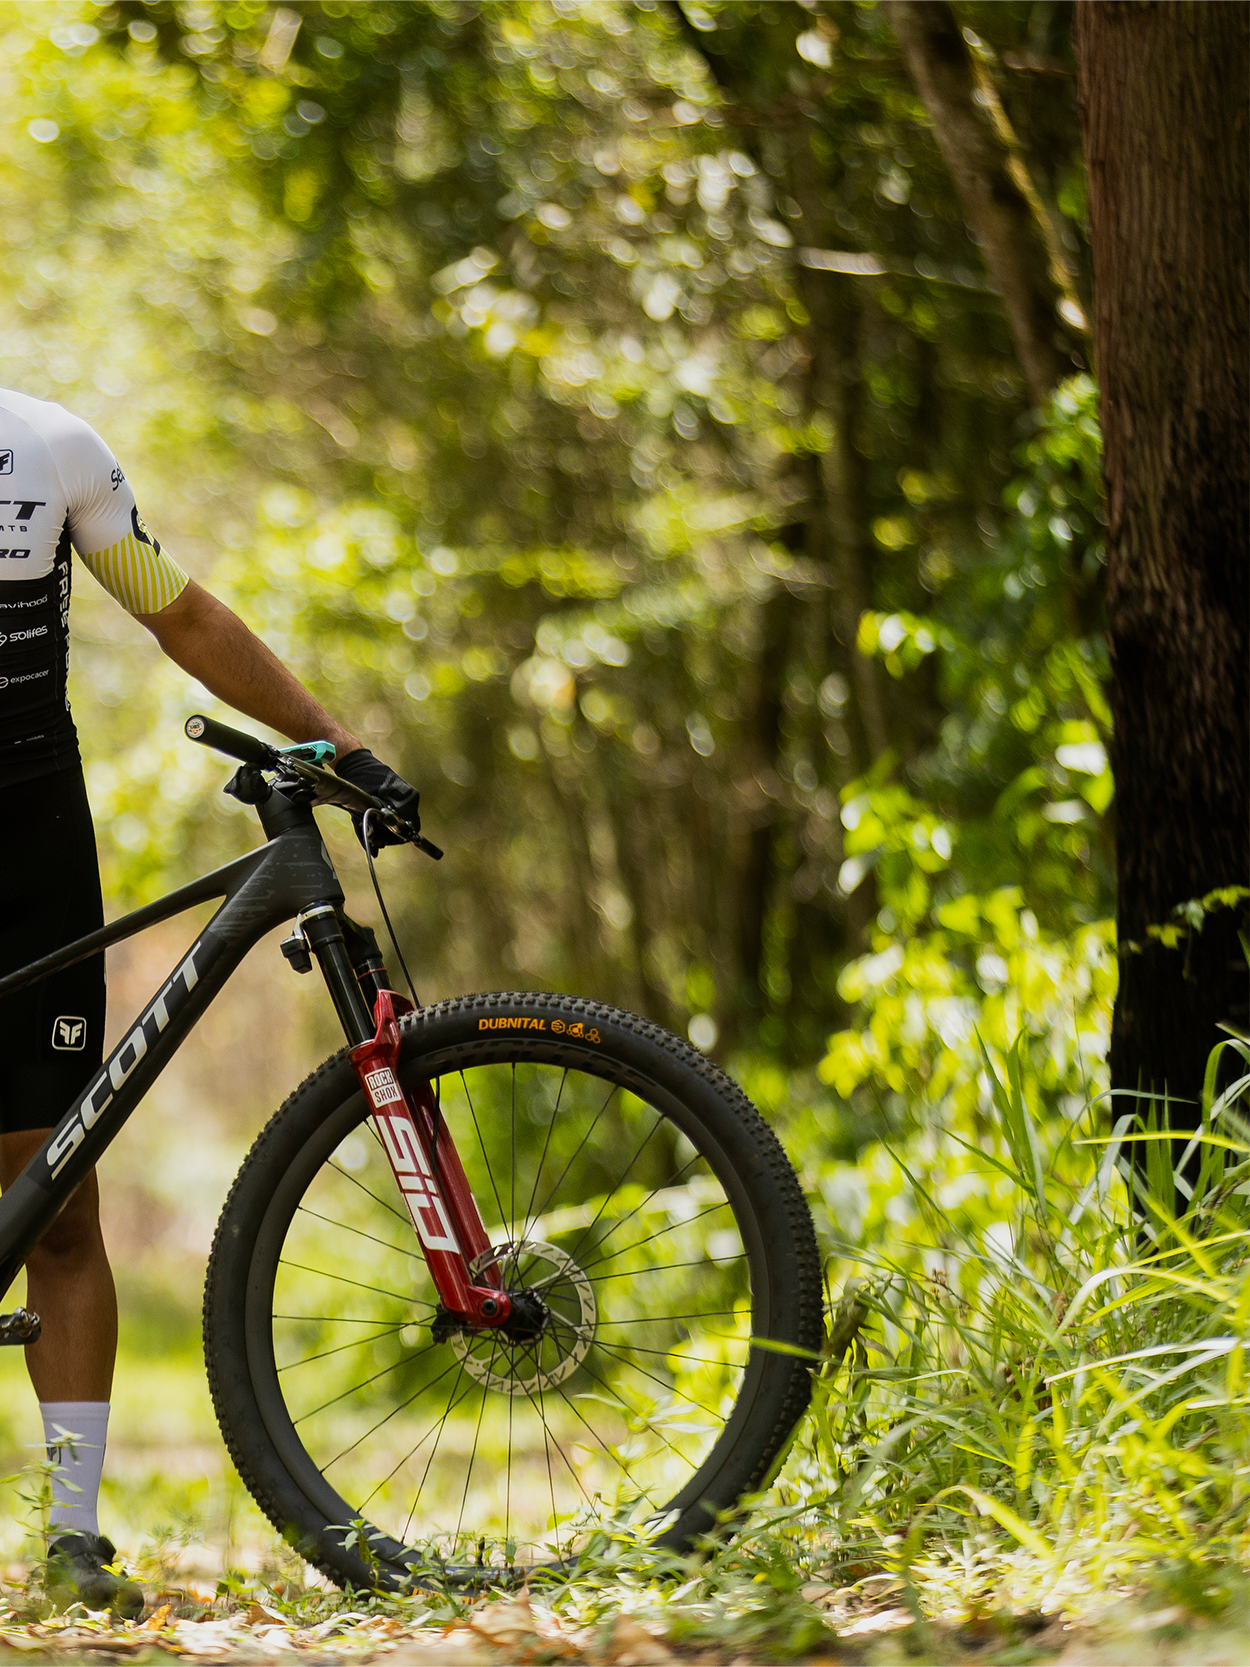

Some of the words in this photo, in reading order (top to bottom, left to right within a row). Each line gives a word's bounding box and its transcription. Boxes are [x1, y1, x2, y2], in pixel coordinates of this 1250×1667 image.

[10, 625, 48, 642] solifes
[10, 670, 49, 683] expocacer
[479, 1018, 546, 1031] DUBNITAL
[47, 940, 201, 1181] SCOTT
[368, 1070, 393, 1090] ROCK
[374, 1086, 398, 1103] SHOX
[376, 1115, 460, 1255] SID
